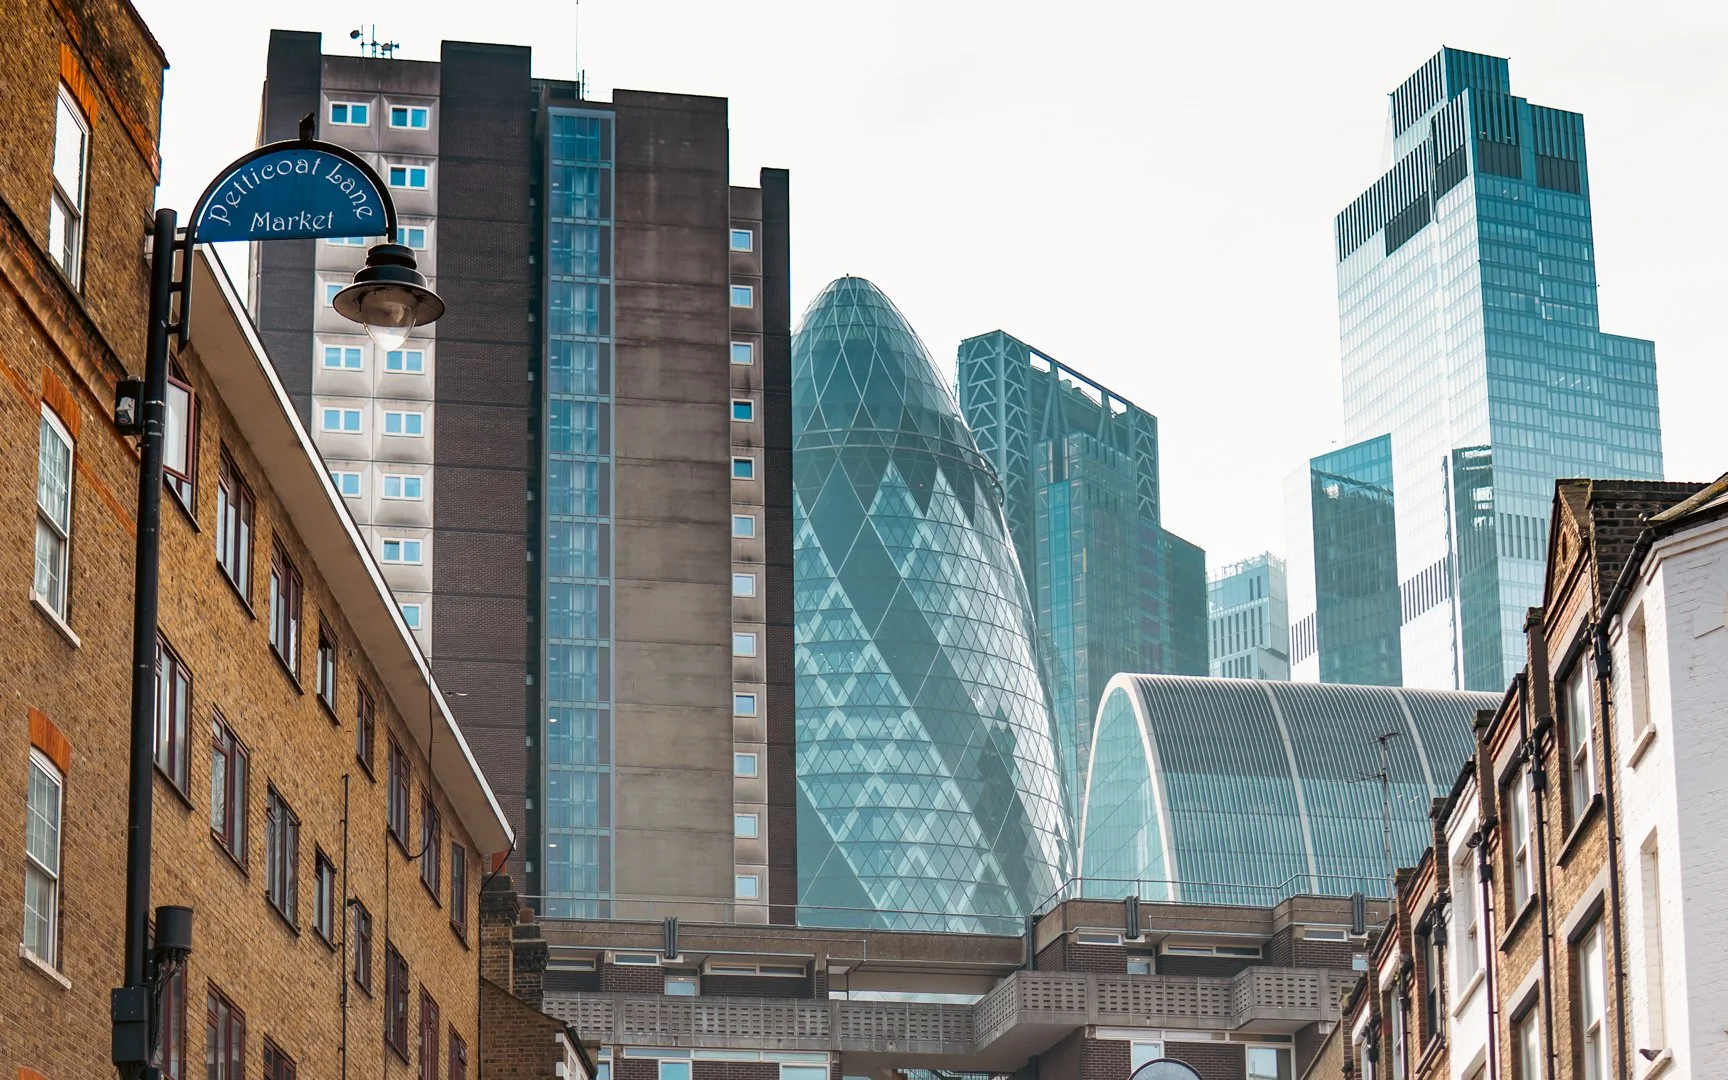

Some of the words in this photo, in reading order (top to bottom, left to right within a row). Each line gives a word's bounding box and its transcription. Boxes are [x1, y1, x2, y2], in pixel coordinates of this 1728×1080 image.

[208, 157, 322, 226] Petticoat
[325, 162, 373, 220] Lane
[250, 210, 334, 232] Market
